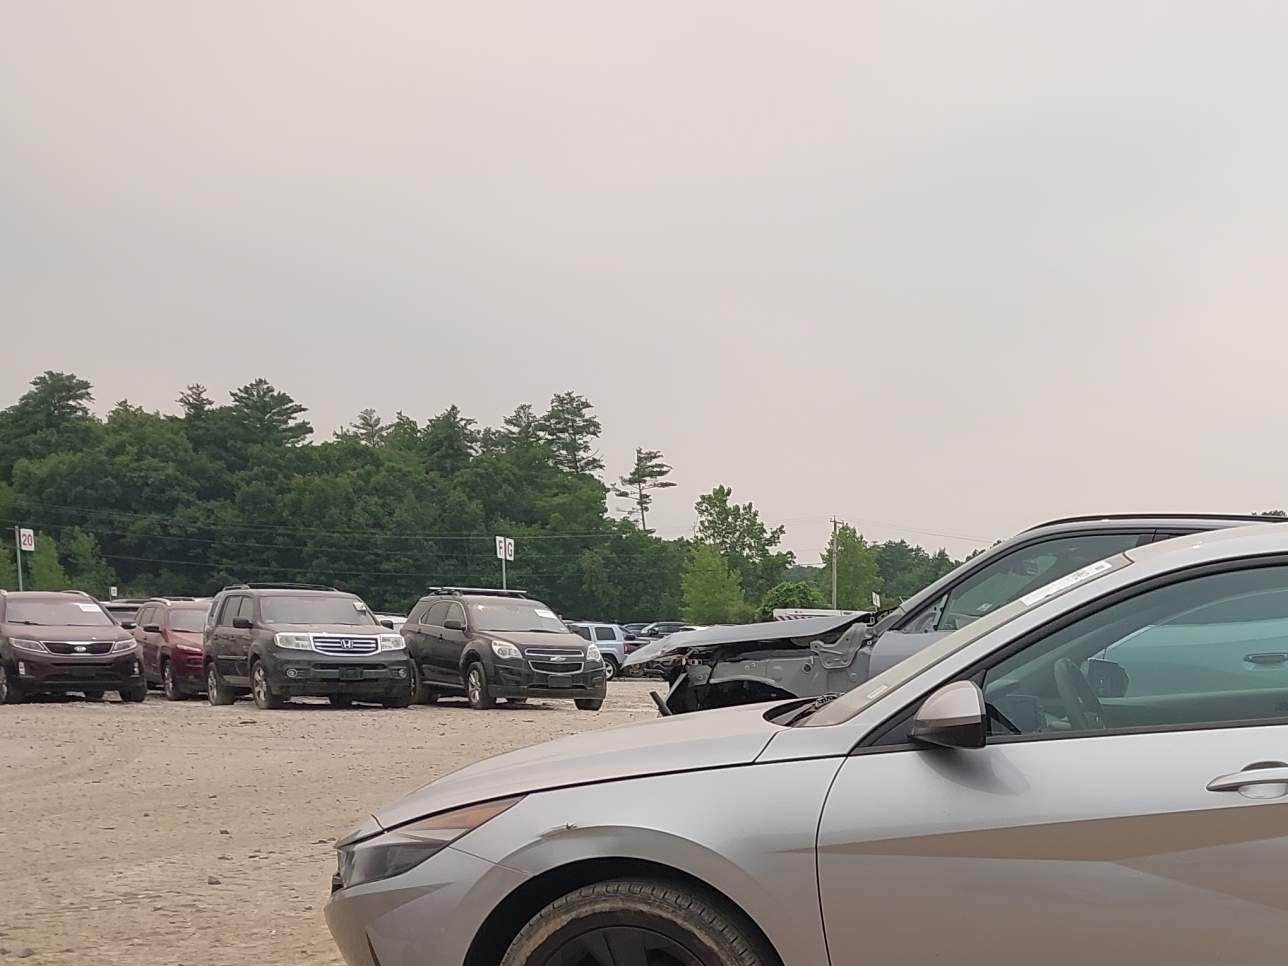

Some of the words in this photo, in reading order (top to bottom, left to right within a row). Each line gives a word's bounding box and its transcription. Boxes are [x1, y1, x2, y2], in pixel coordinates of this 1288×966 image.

[22, 533, 33, 547] 20
[498, 540, 504, 557] F
[507, 542, 513, 557] G
